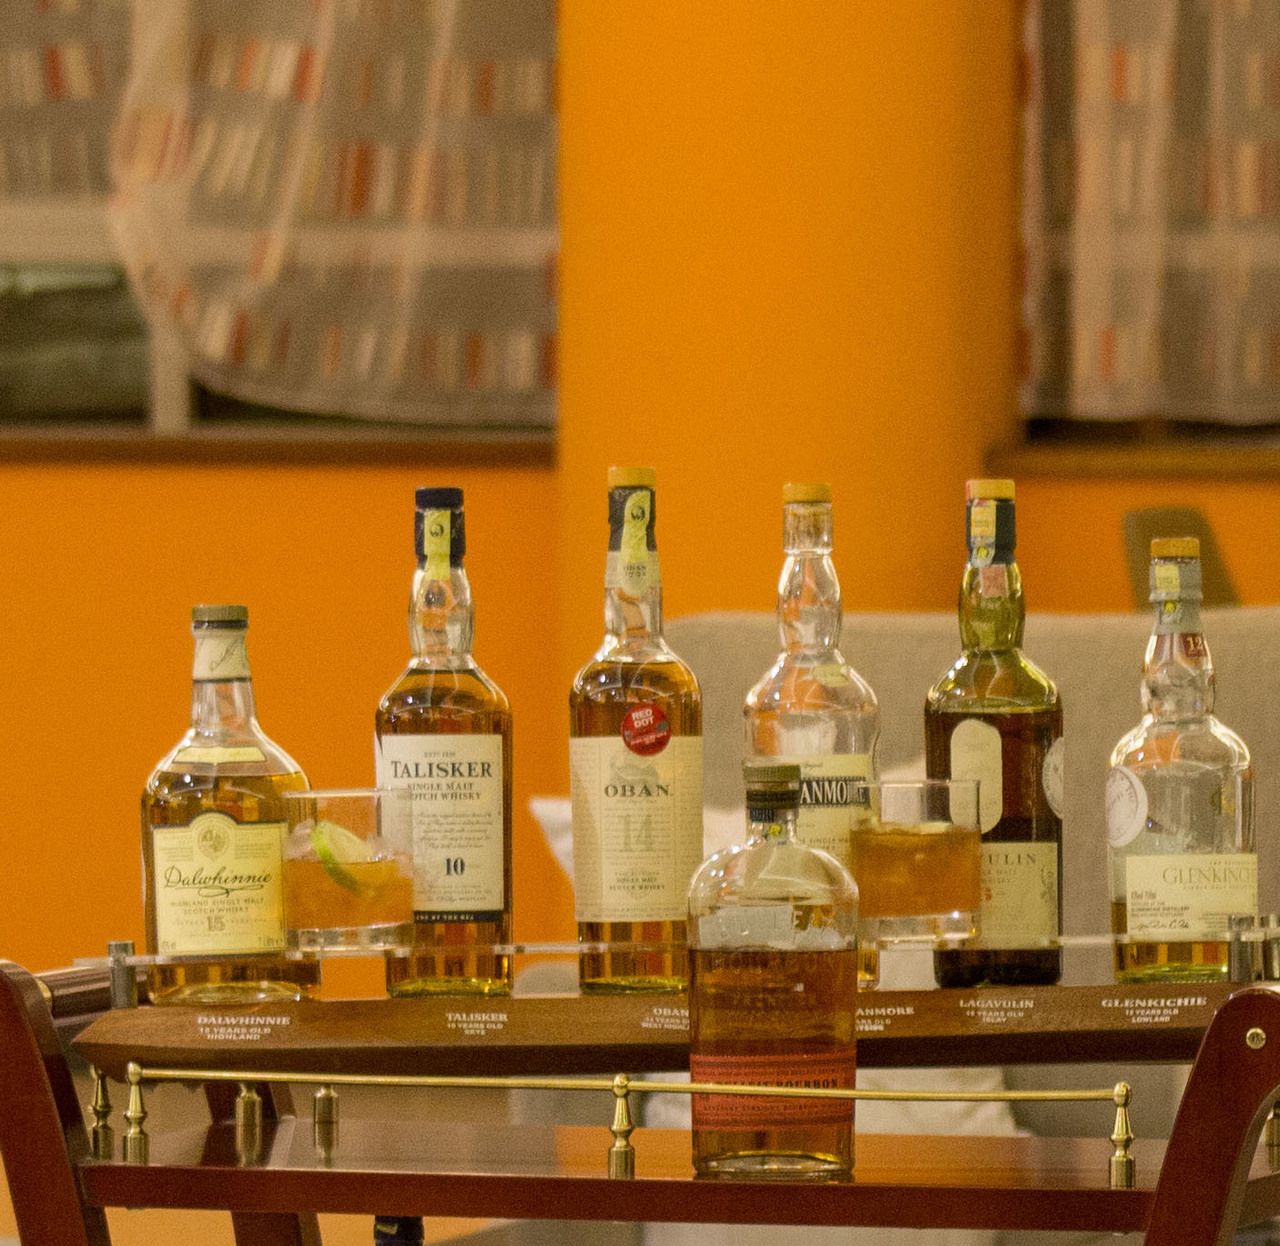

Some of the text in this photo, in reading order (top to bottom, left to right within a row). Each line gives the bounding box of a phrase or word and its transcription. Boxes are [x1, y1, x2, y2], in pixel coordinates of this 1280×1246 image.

[631, 708, 653, 721] RED
[633, 716, 655, 729] DOT
[391, 760, 493, 779] TALISKER
[407, 782, 474, 791] SINGLE MALT
[604, 784, 671, 798] OBAN
[441, 791, 481, 800] WHISKY
[619, 814, 657, 853] 14
[445, 857, 466, 876] 10
[164, 864, 273, 890] Dalwhinnie
[207, 915, 227, 932] 15
[960, 1000, 1034, 1009] LAGAVULIN
[653, 1007, 690, 1017] OBAN
[855, 1006, 916, 1016] ANMORE
[197, 1015, 291, 1025] DALWHINNIE
[446, 1012, 508, 1022] TALISKER
[213, 1026, 248, 1034] YEARS
[249, 1026, 272, 1034] OLD
[207, 1033, 261, 1041] HIGHLAND
